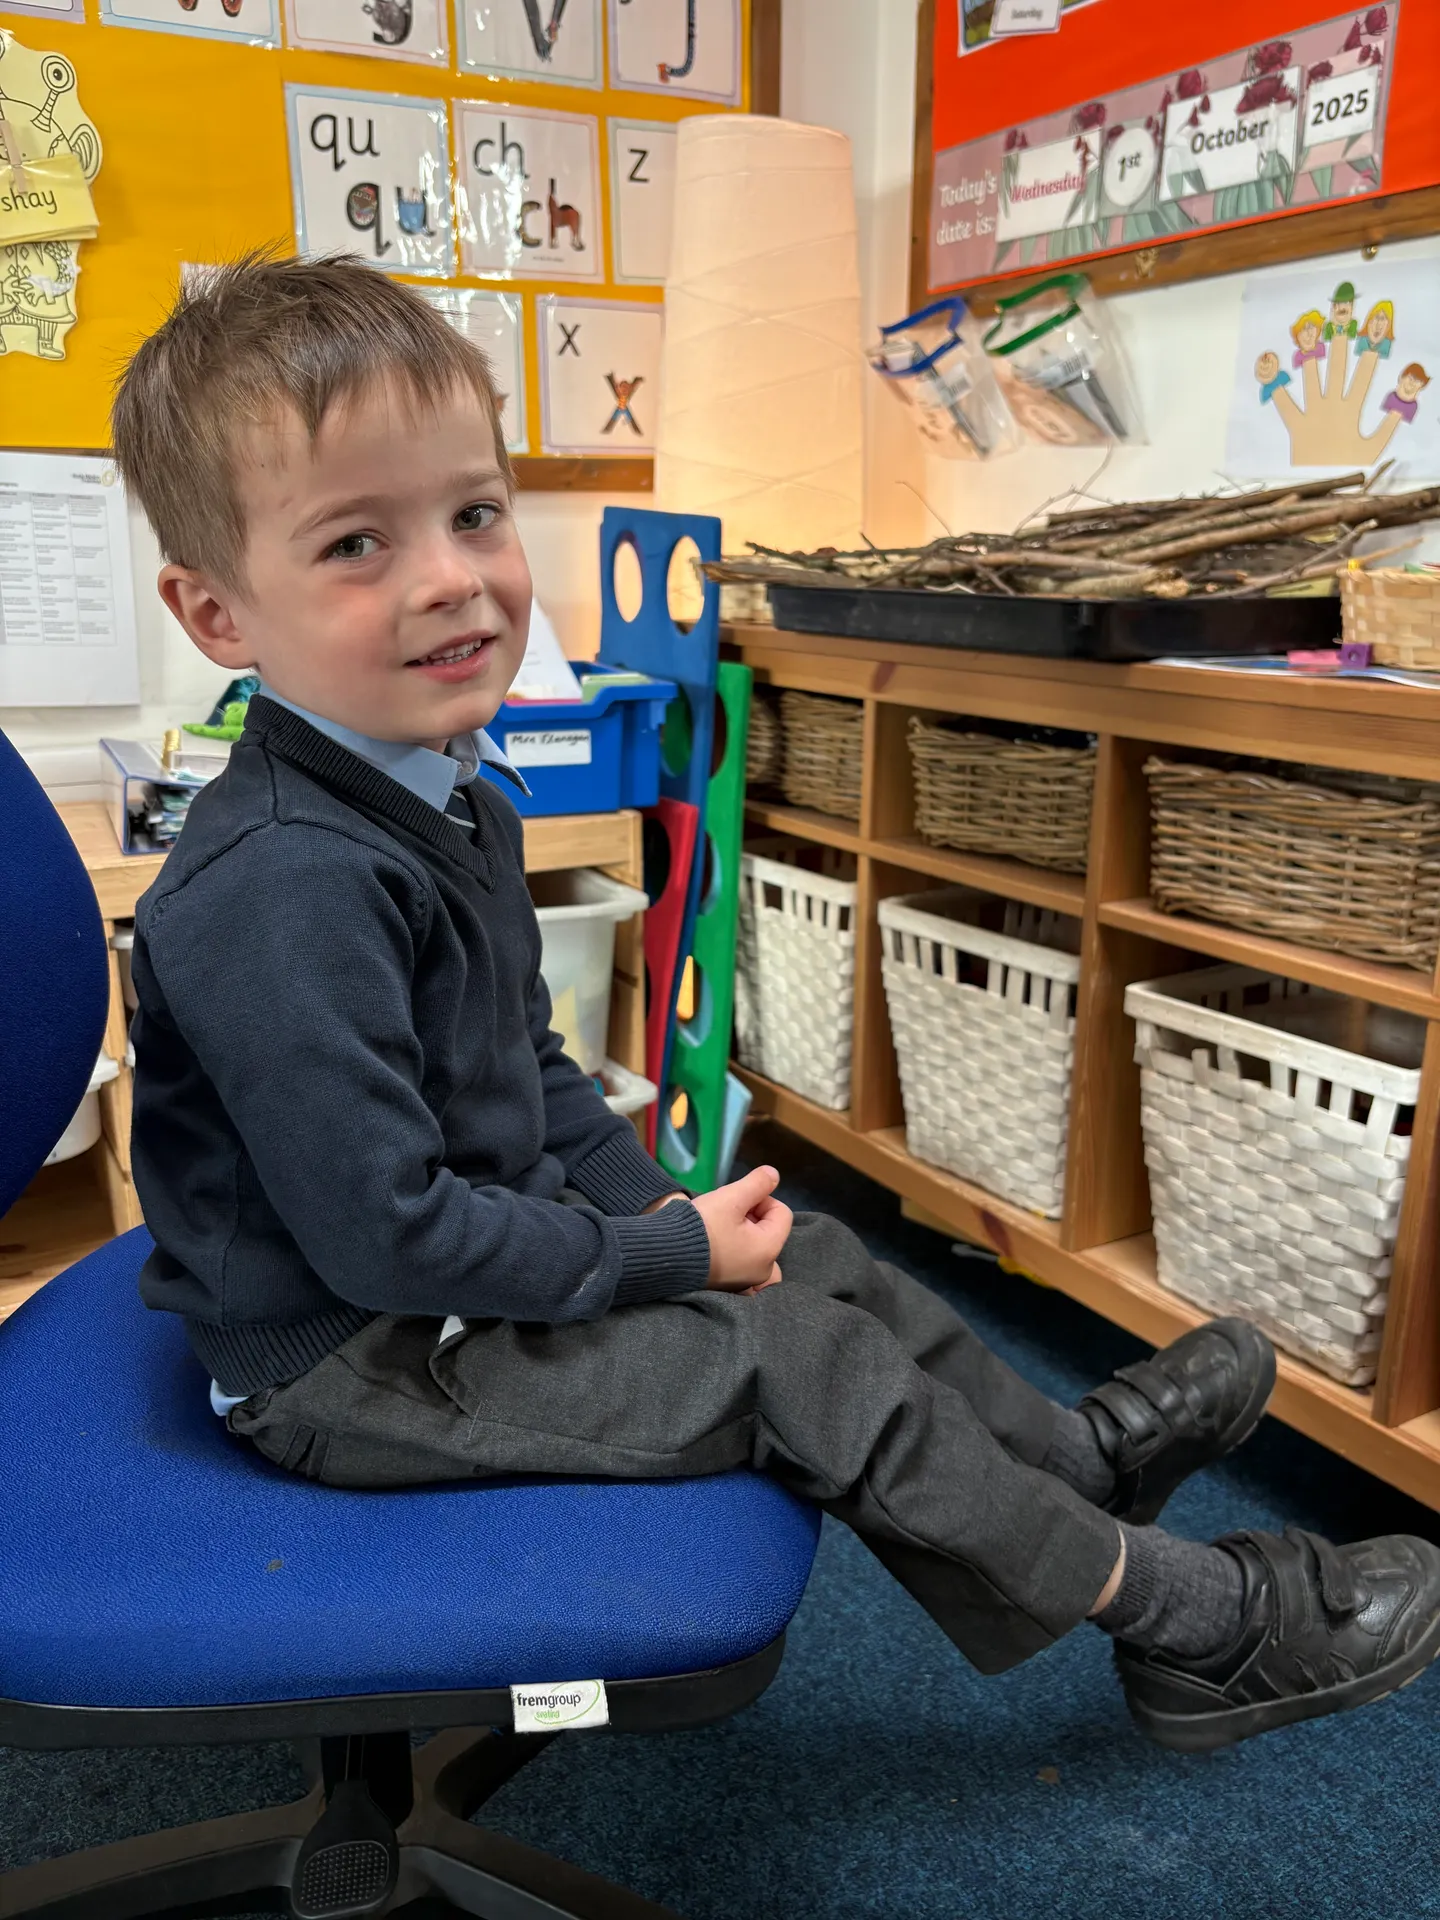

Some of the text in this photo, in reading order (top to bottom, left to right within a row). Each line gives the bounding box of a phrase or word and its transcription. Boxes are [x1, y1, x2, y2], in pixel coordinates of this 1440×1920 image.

[1311, 89, 1369, 127] 2025
[310, 113, 380, 171] qu
[473, 121, 530, 179] ch
[1190, 119, 1269, 154] October
[1118, 152, 1142, 182] 1st
[1, 187, 58, 215] shay
[939, 170, 997, 208] Today's
[516, 1692, 581, 1708] fremgroup
